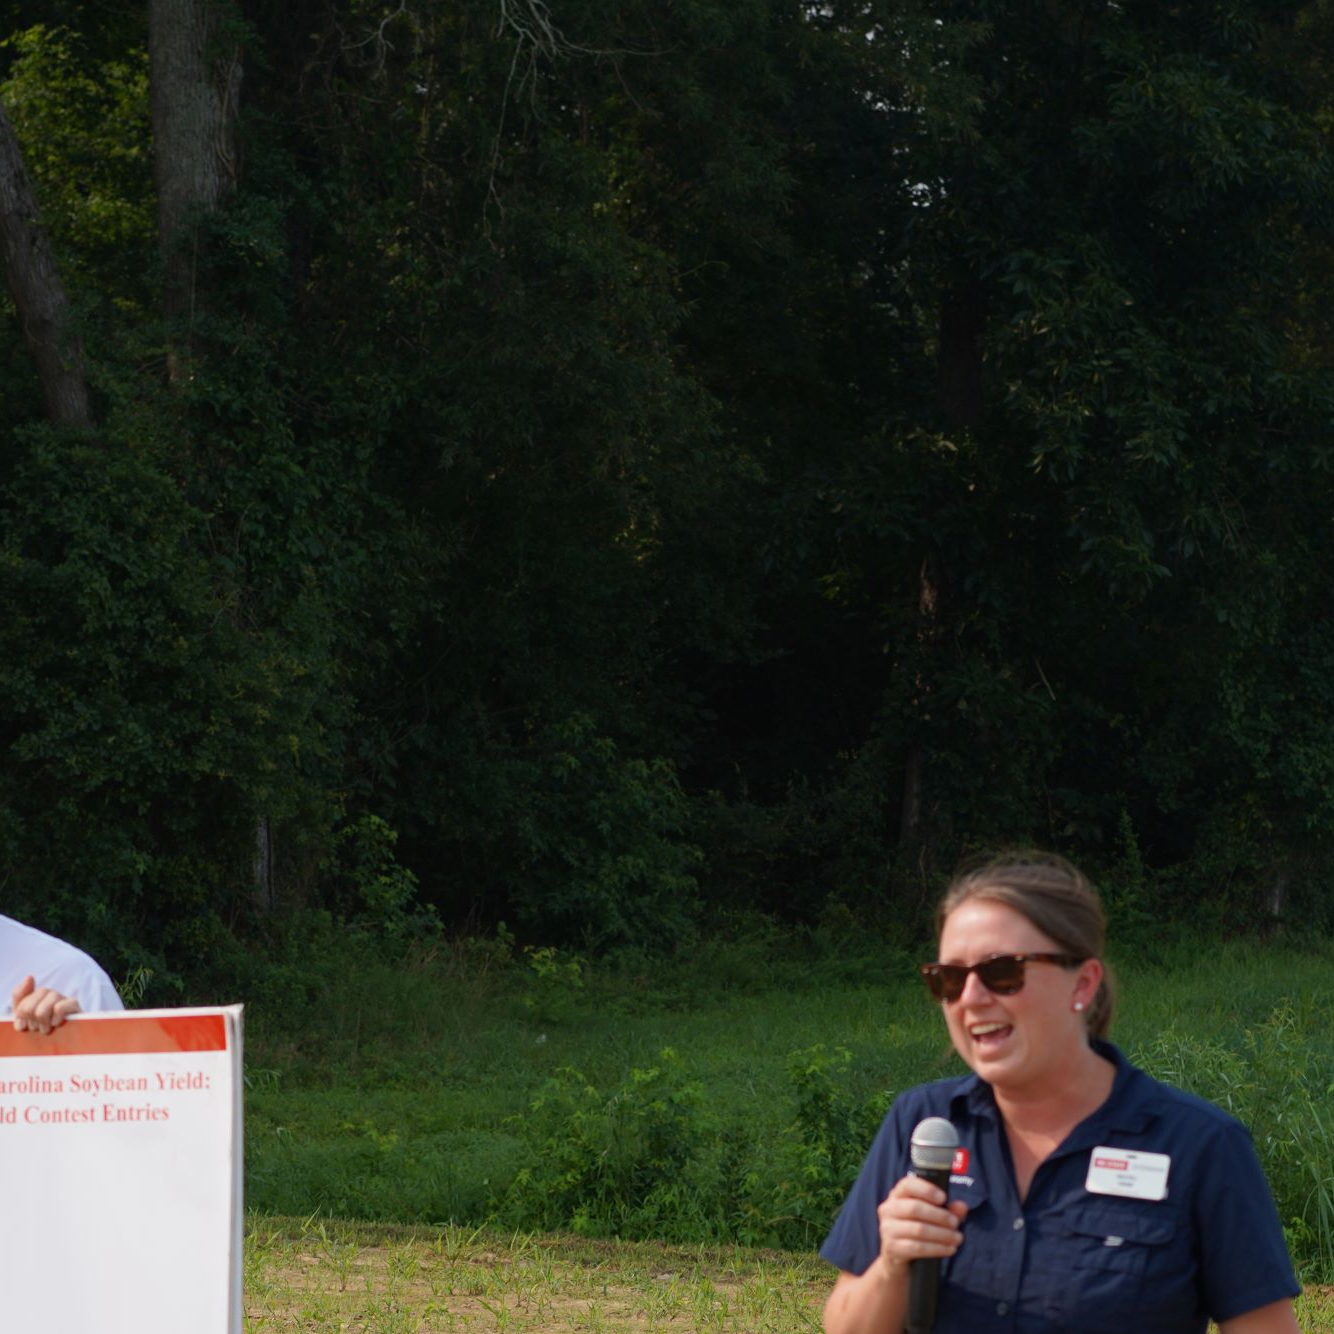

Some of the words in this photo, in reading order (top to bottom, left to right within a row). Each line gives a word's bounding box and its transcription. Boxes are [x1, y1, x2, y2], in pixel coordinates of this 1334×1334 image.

[70, 1073, 148, 1097] Soybean
[155, 1071, 211, 1091] Yield:
[23, 1104, 95, 1124] Contest
[103, 1103, 170, 1122] Entries
